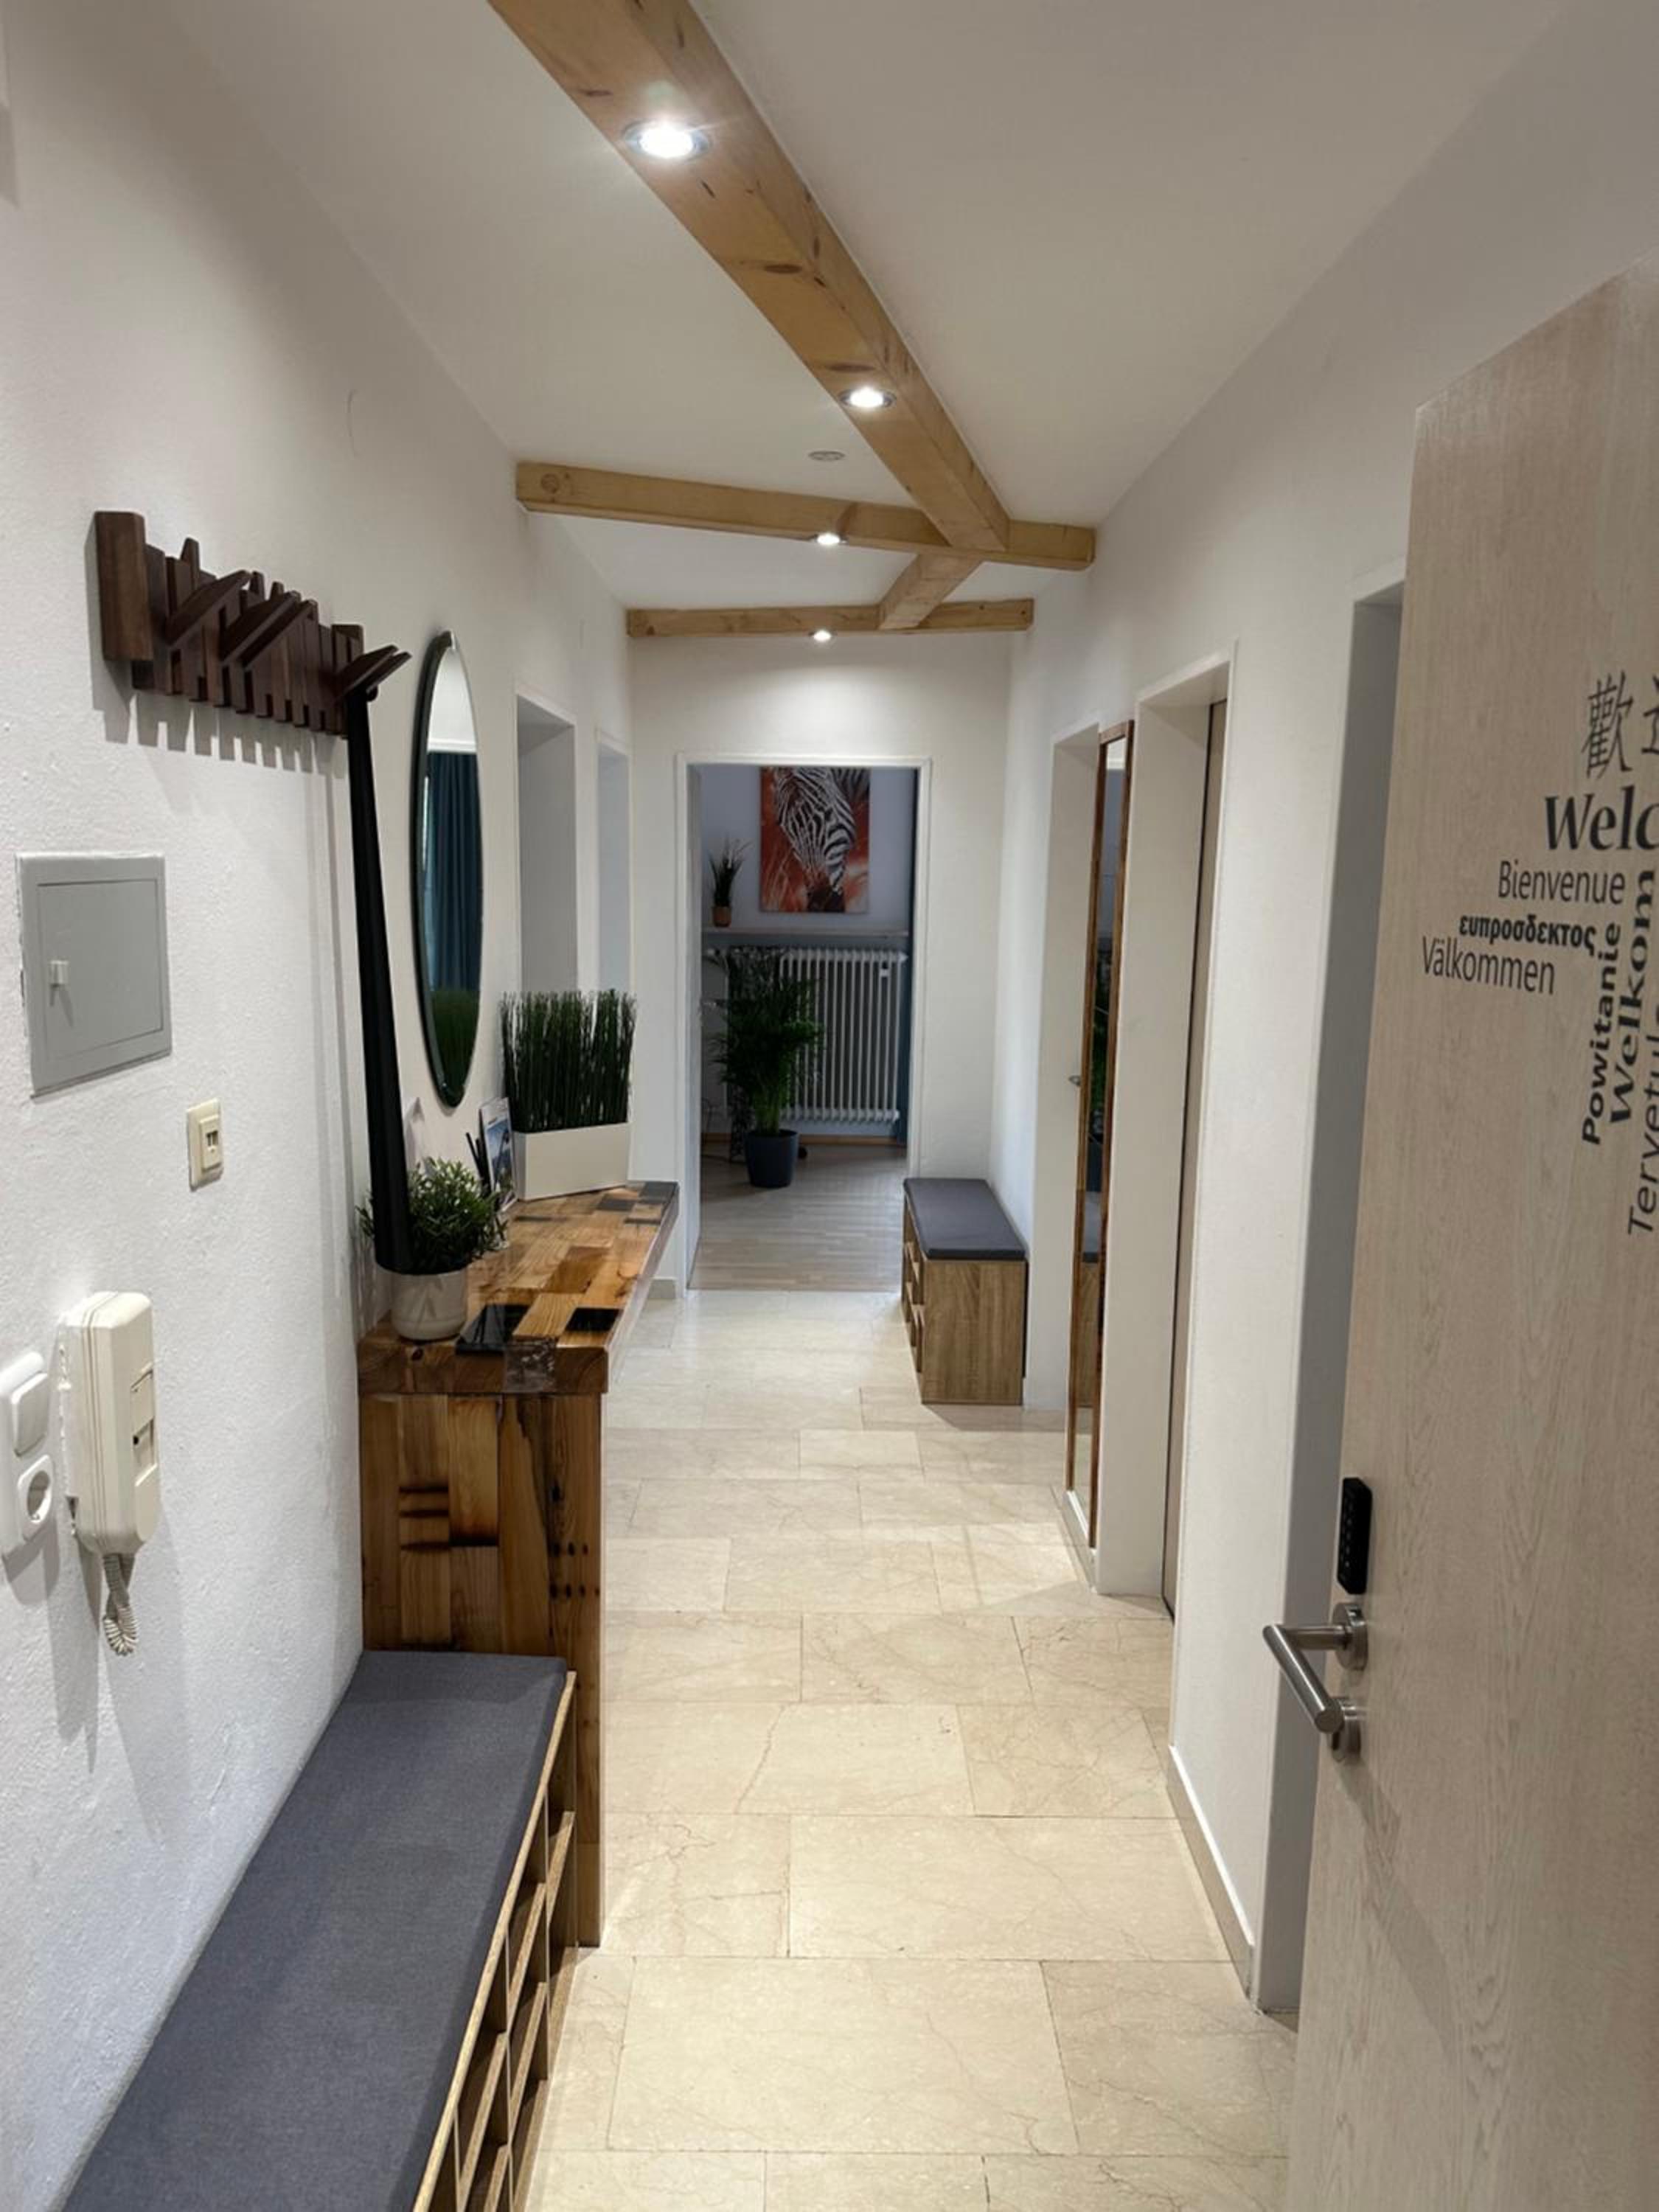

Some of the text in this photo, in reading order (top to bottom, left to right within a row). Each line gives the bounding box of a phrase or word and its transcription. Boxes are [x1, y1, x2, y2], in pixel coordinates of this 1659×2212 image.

[1498, 859, 1626, 905] Bienvenue
[1545, 784, 1659, 851] Welc
[1422, 936, 1556, 995] Välkommen
[1582, 922, 1621, 1145] Powitanie
[1609, 869, 1656, 1124] Welkom
[1627, 1004, 1659, 1236] Tervetl
